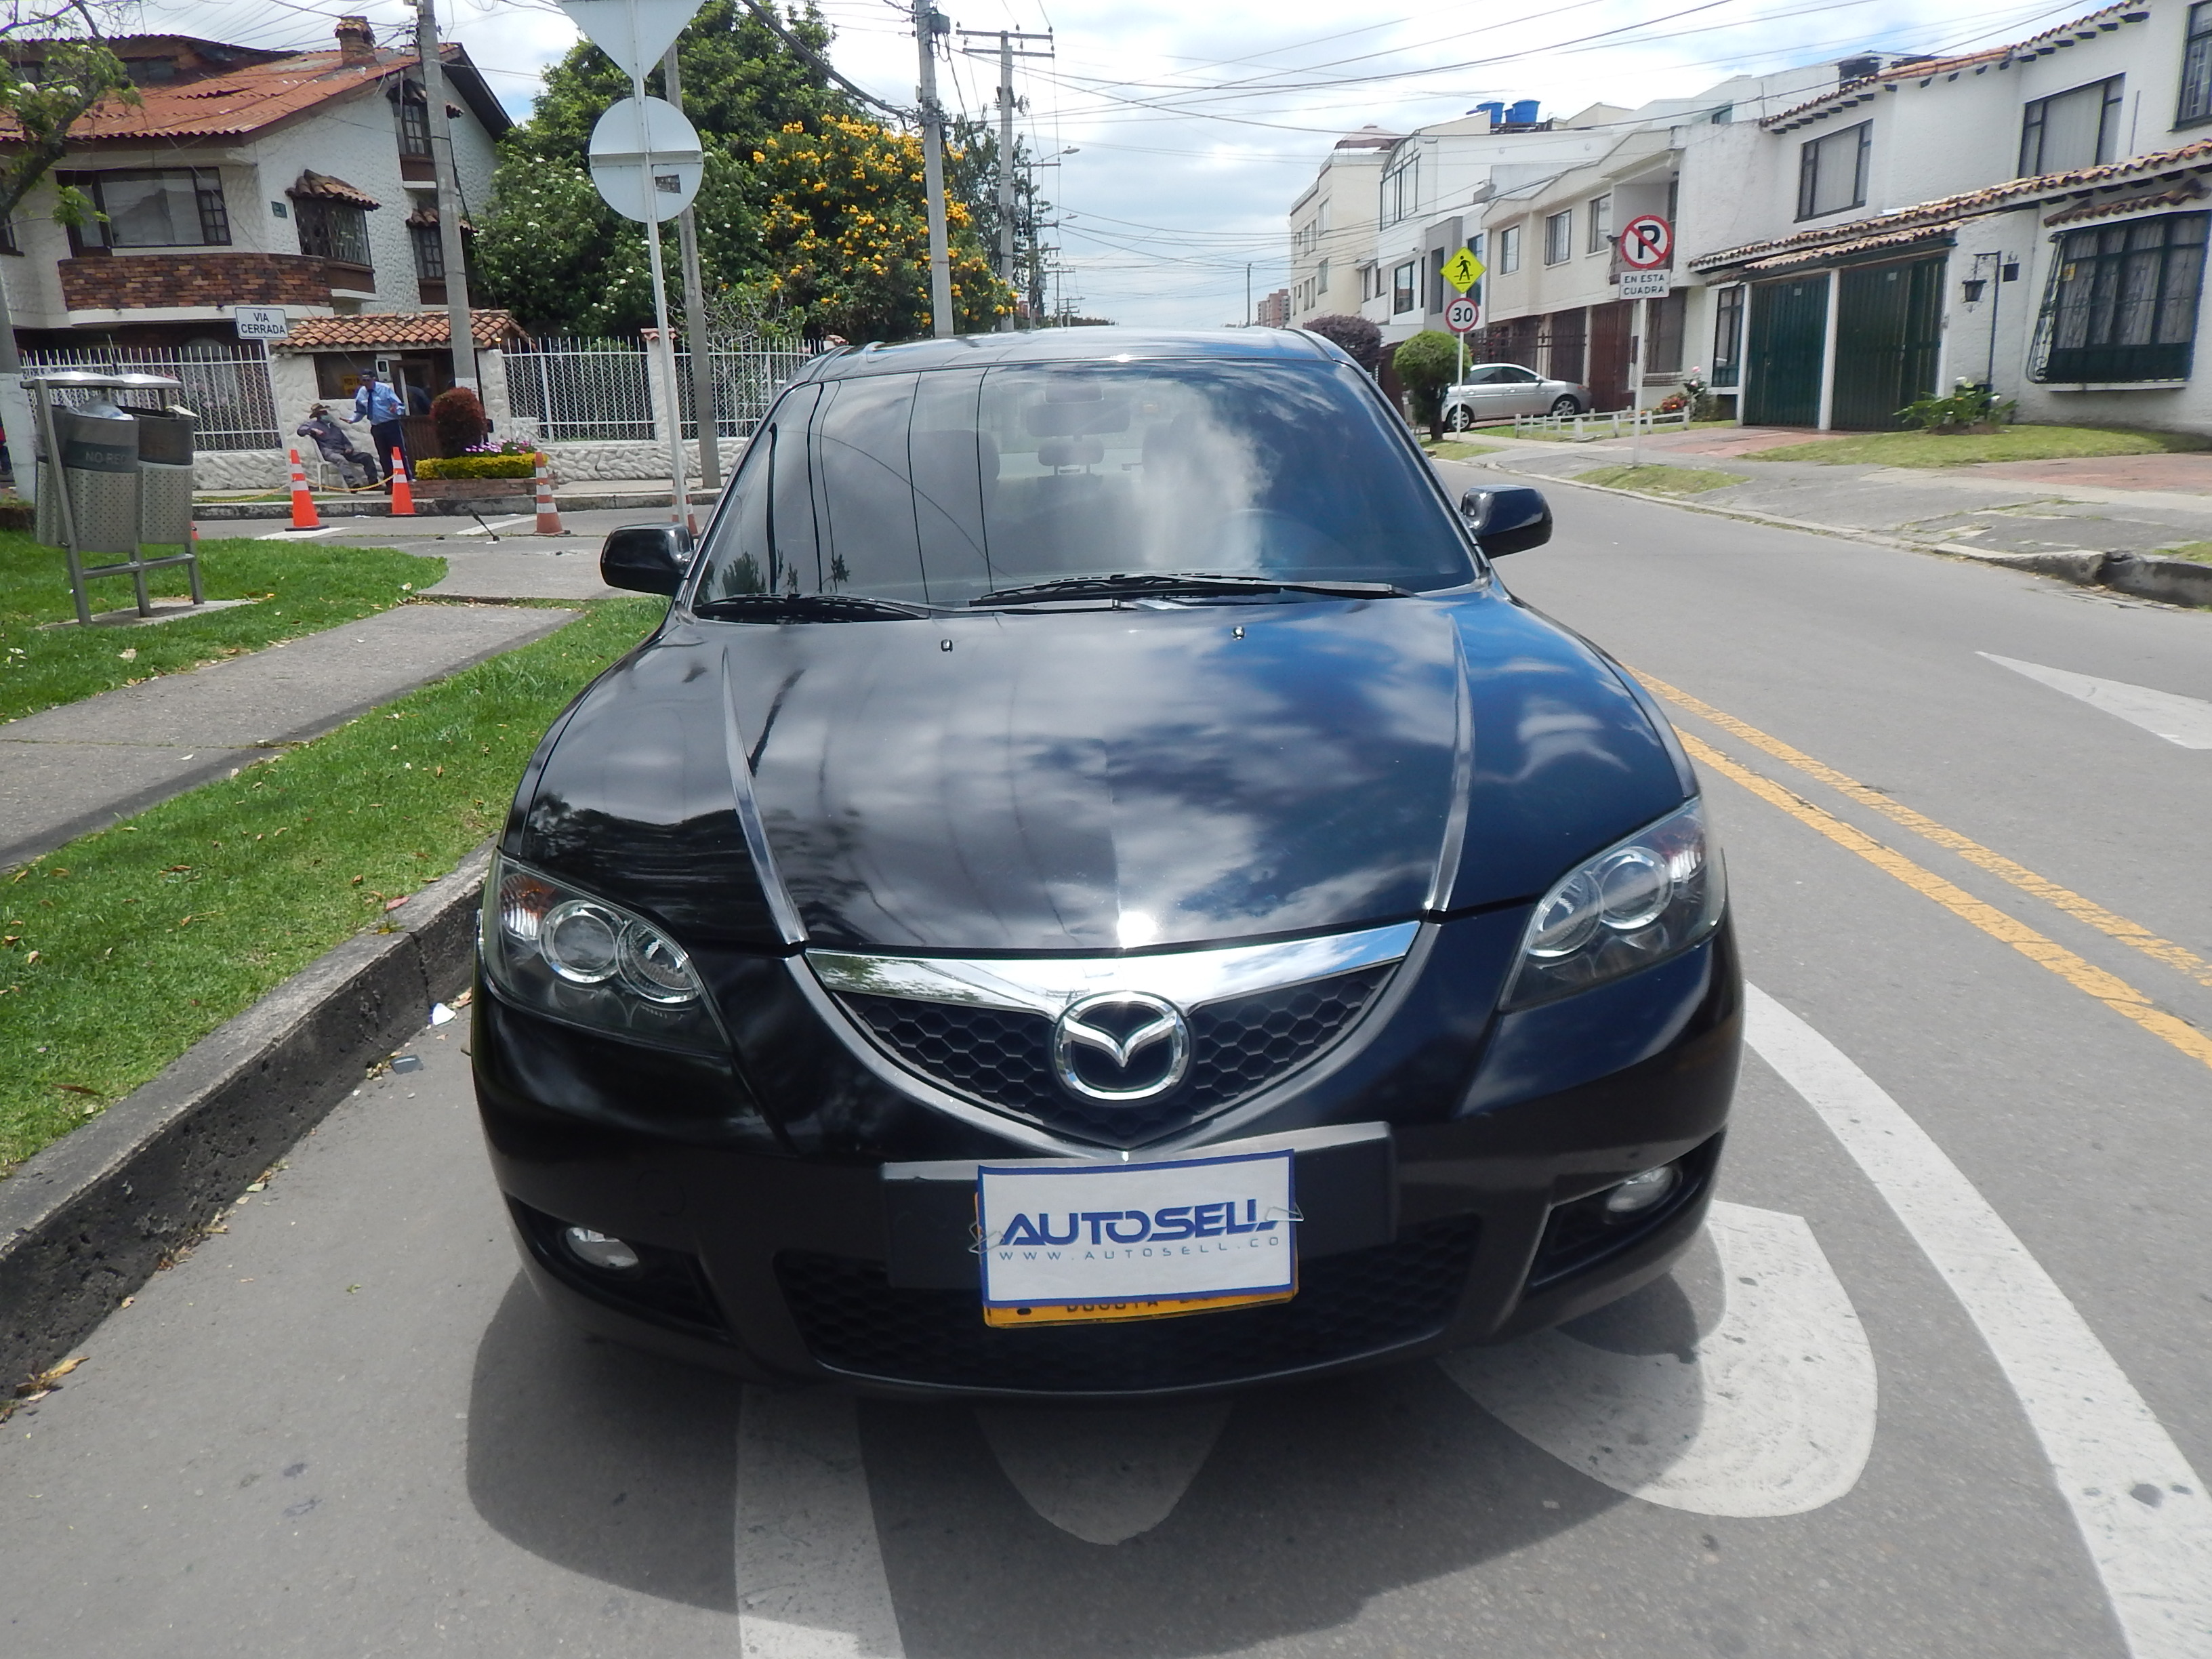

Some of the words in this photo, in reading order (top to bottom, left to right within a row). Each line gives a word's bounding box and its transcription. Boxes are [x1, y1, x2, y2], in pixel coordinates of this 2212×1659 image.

[1638, 224, 1660, 259] P
[1624, 275, 1637, 284] EN
[1641, 274, 1664, 283] ESTA
[1624, 285, 1664, 295] CUADRA
[253, 312, 270, 322] VIA
[1453, 307, 1473, 322] 30
[241, 323, 286, 334] CERRADA
[85, 451, 104, 464] NO
[999, 1198, 1279, 1246] AUTOSELL
[999, 1235, 1279, 1261] WWW.AUTOSELL.CO
